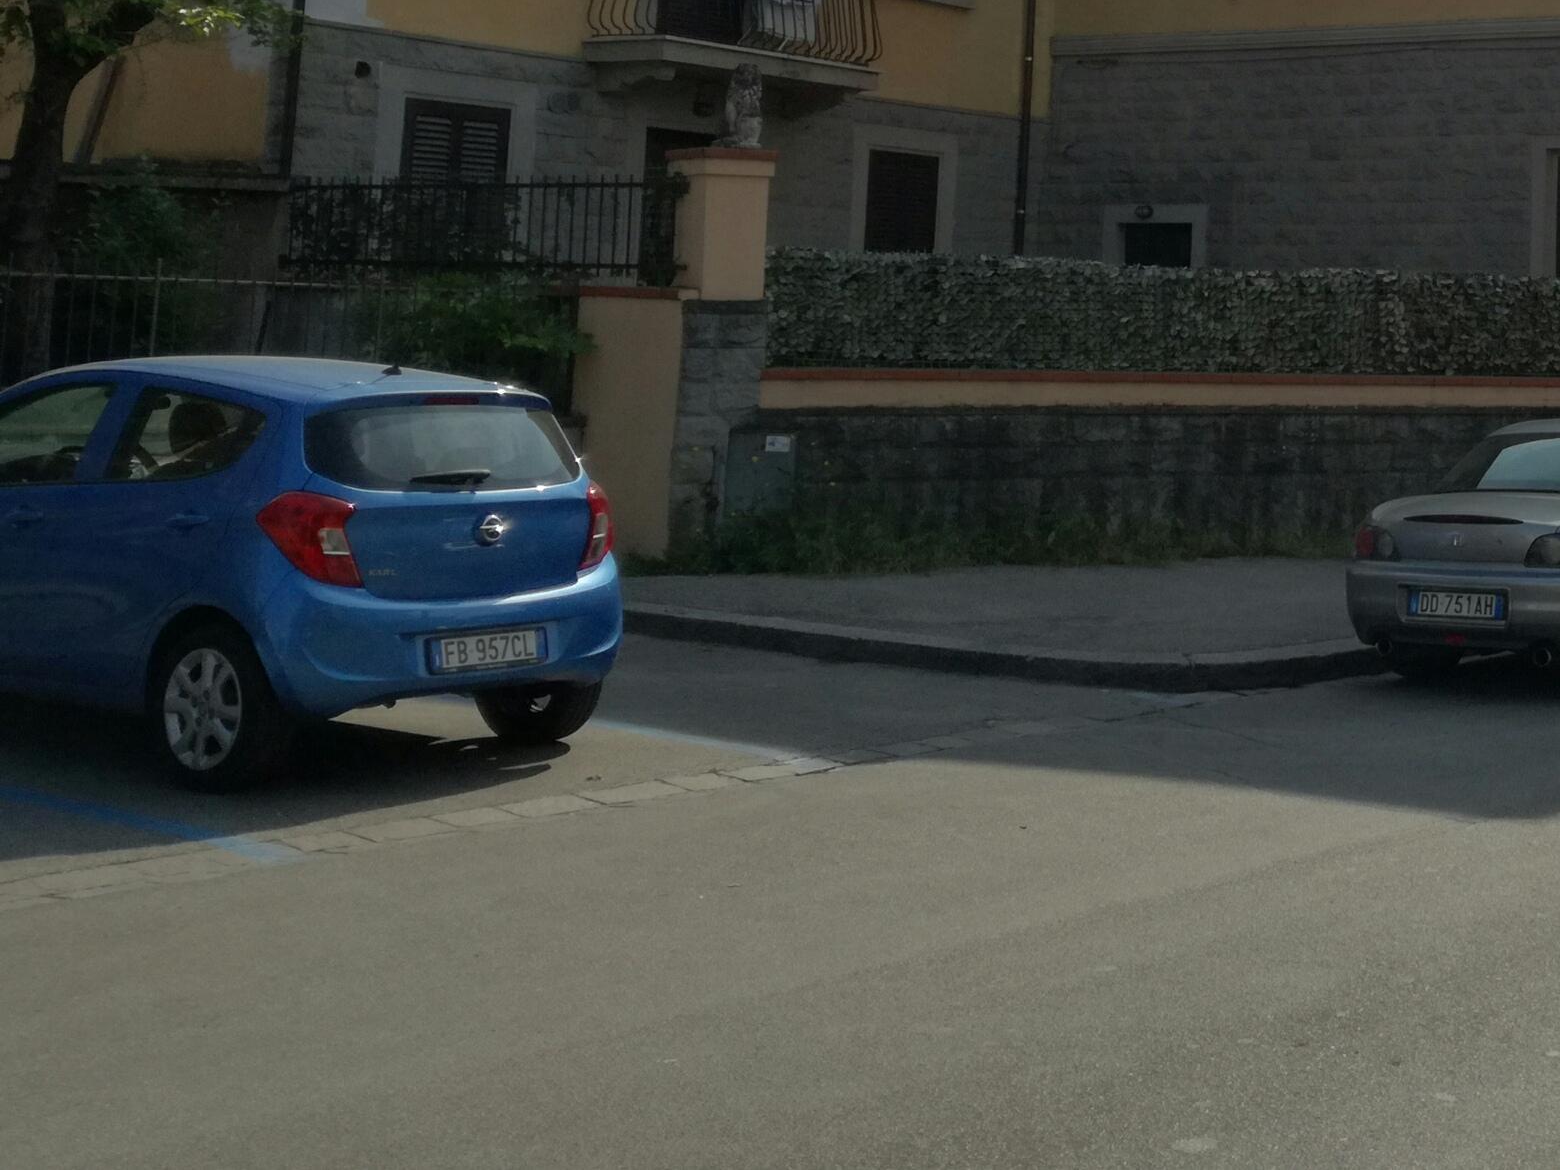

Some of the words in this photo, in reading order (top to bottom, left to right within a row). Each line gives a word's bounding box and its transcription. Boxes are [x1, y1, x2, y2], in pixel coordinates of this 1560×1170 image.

[1420, 593, 1439, 612] DD
[1444, 594, 1493, 615] 751AH
[443, 640, 468, 666] FB
[477, 634, 534, 662] 957CL
